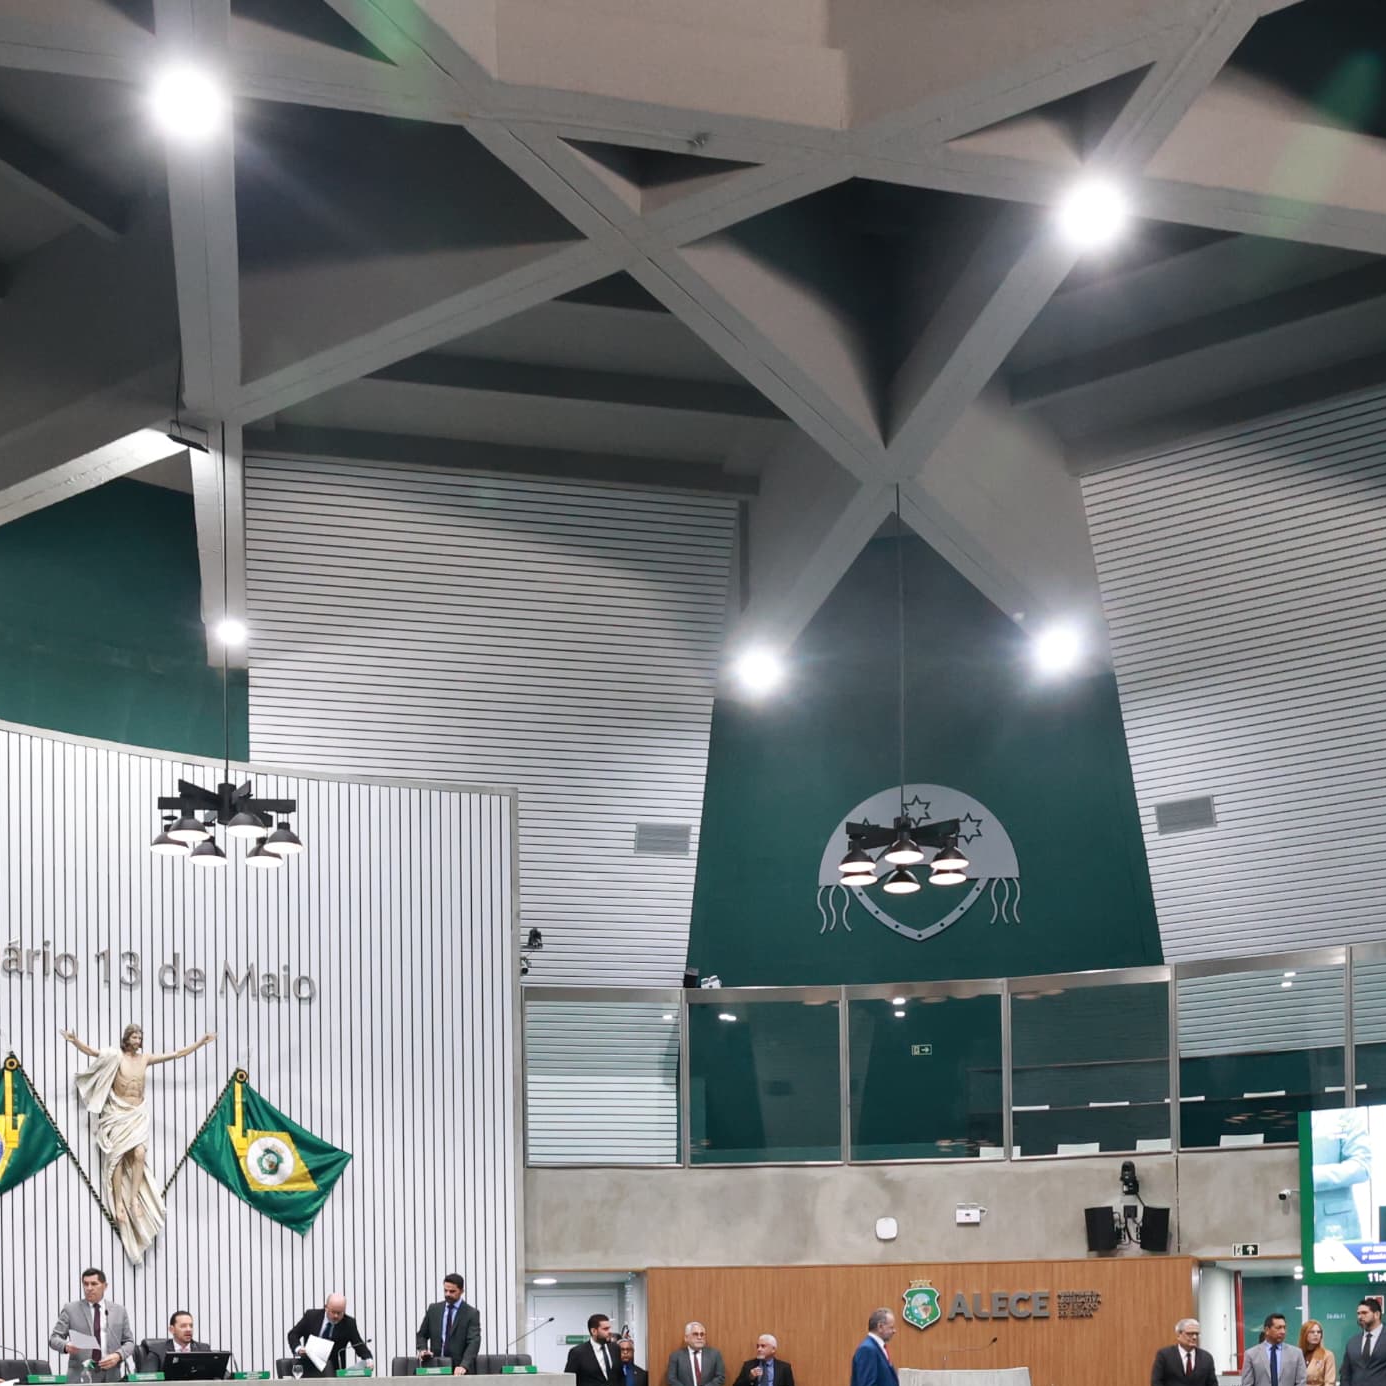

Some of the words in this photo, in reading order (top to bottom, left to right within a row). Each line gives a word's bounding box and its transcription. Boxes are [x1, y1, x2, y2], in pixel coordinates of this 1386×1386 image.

[94, 946, 141, 990] 13
[158, 952, 206, 993] de
[219, 960, 316, 1001] Maio
[948, 1289, 1050, 1319] ALECE
